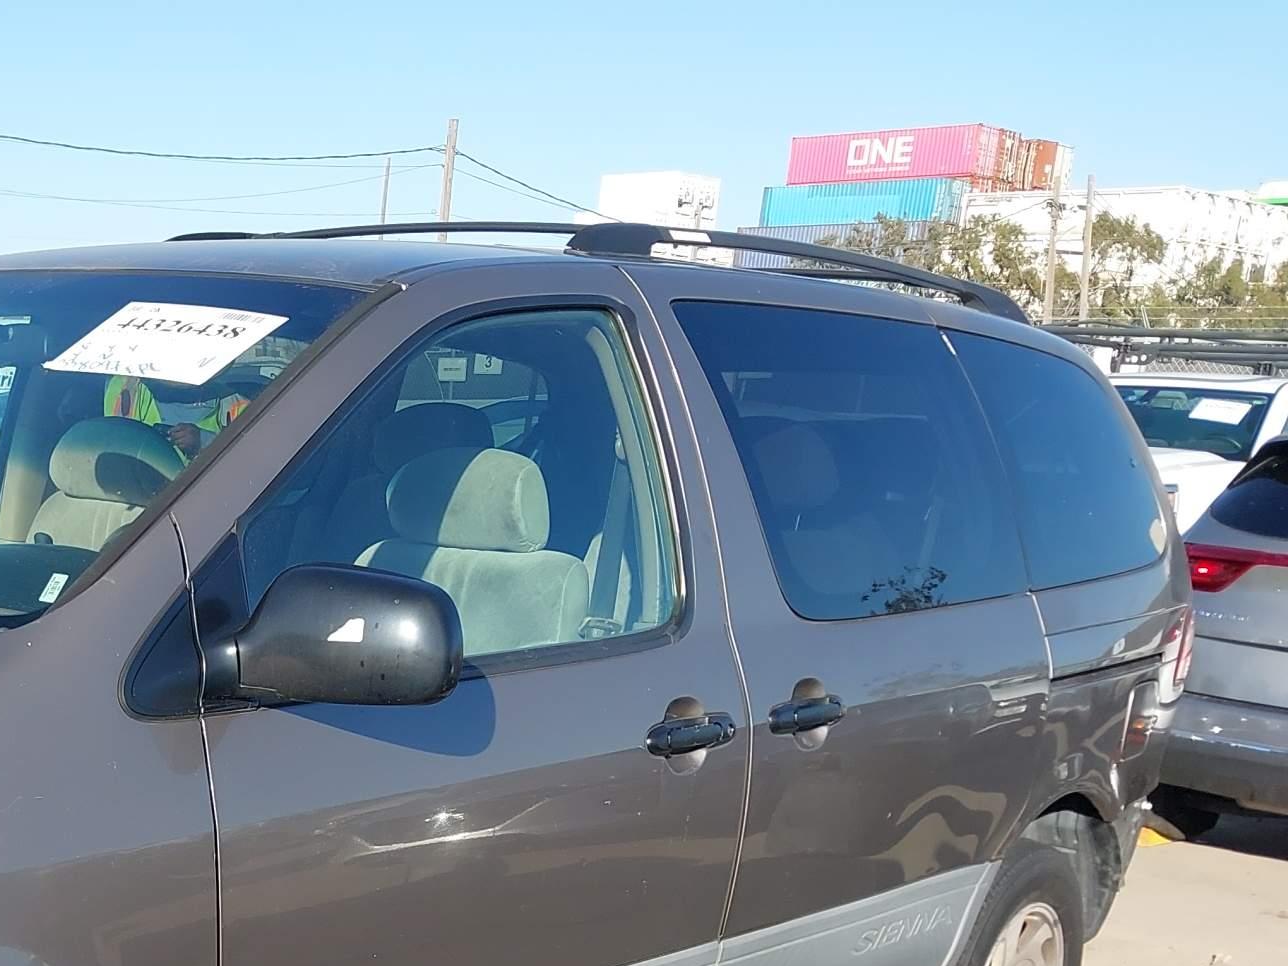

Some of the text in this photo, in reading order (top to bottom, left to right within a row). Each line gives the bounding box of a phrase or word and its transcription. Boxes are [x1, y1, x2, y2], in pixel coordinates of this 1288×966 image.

[847, 136, 914, 165] ONE
[118, 317, 246, 338] 44326438
[485, 356, 492, 368] 3
[852, 905, 952, 955] SIENNA
